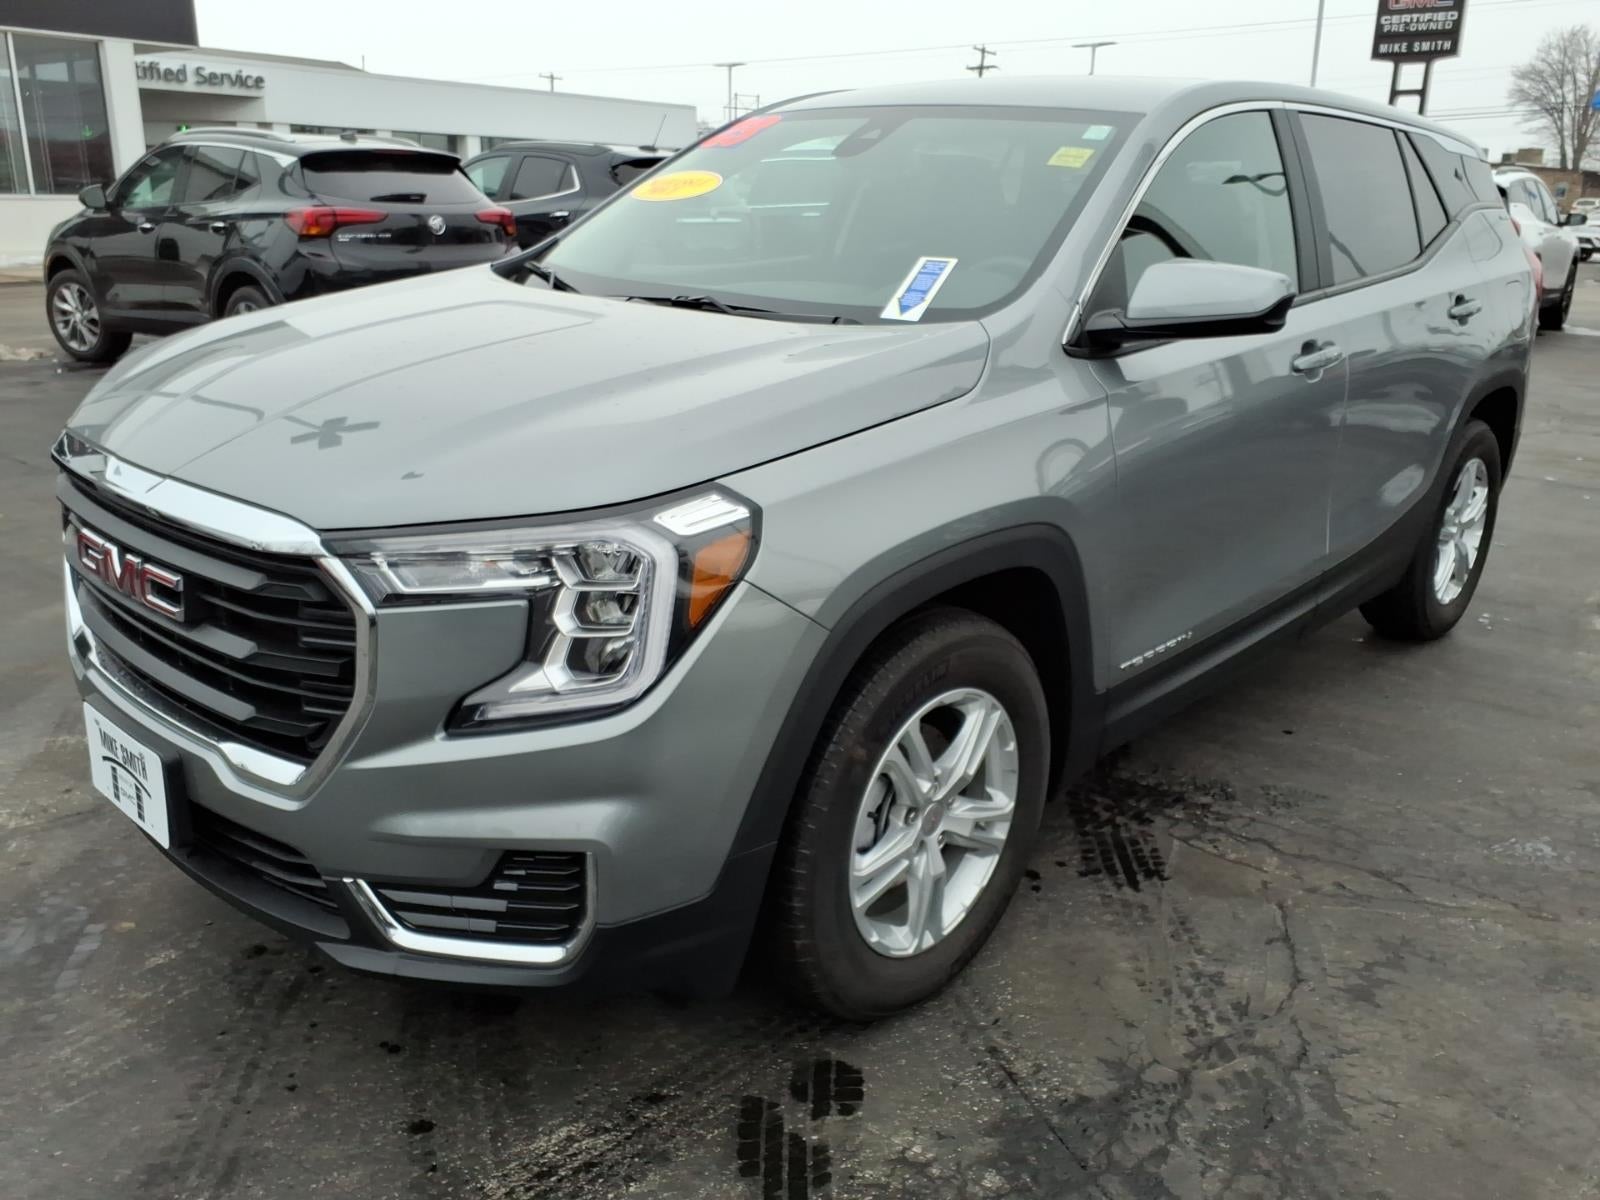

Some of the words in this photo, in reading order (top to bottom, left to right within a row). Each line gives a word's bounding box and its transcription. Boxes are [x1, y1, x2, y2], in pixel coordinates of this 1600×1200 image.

[1380, 11, 1458, 25] CERTIFIED
[1383, 21, 1453, 33] PRE-OWNED
[1379, 42, 1407, 54] MIKE
[1413, 40, 1452, 52] SMITH
[194, 66, 265, 89] Service
[78, 527, 184, 622] GMC
[99, 727, 119, 760] MIKE
[120, 744, 148, 782] SMITH
